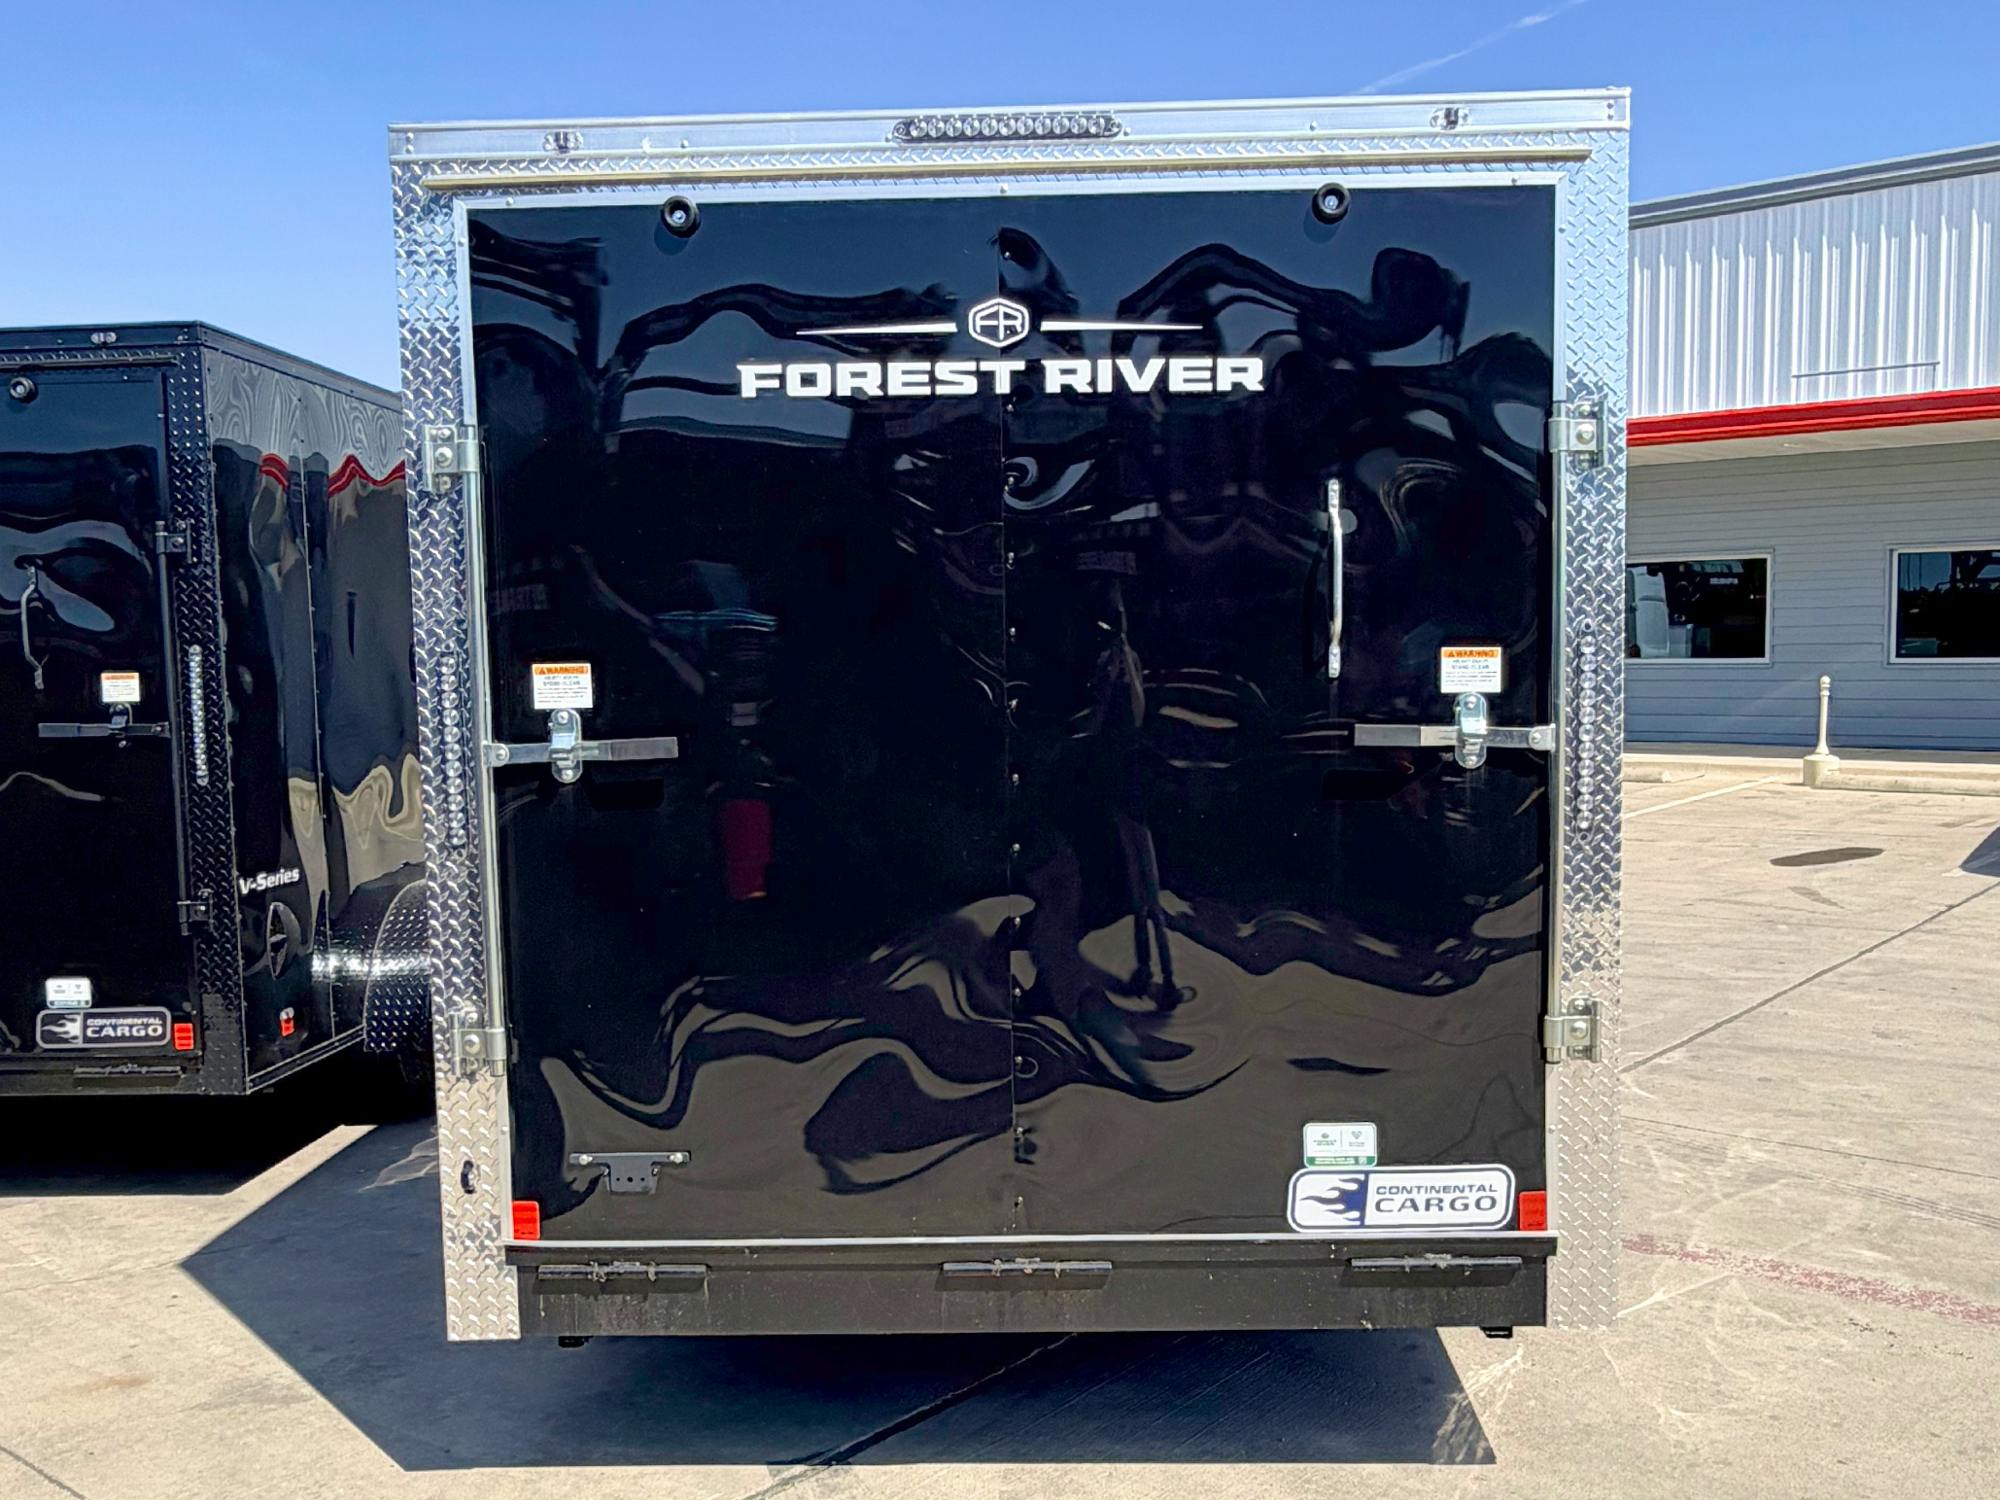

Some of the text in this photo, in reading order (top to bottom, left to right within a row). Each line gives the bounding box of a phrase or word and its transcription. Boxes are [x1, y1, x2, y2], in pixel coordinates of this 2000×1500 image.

[736, 356, 1265, 398] FOREST RIVER
[239, 867, 300, 895] V-Series
[86, 1017, 163, 1026] CONTINENTAL
[86, 1025, 163, 1038] CARGO
[1375, 1184, 1498, 1195] CONTINENTAL
[1374, 1195, 1498, 1213] CARGO
